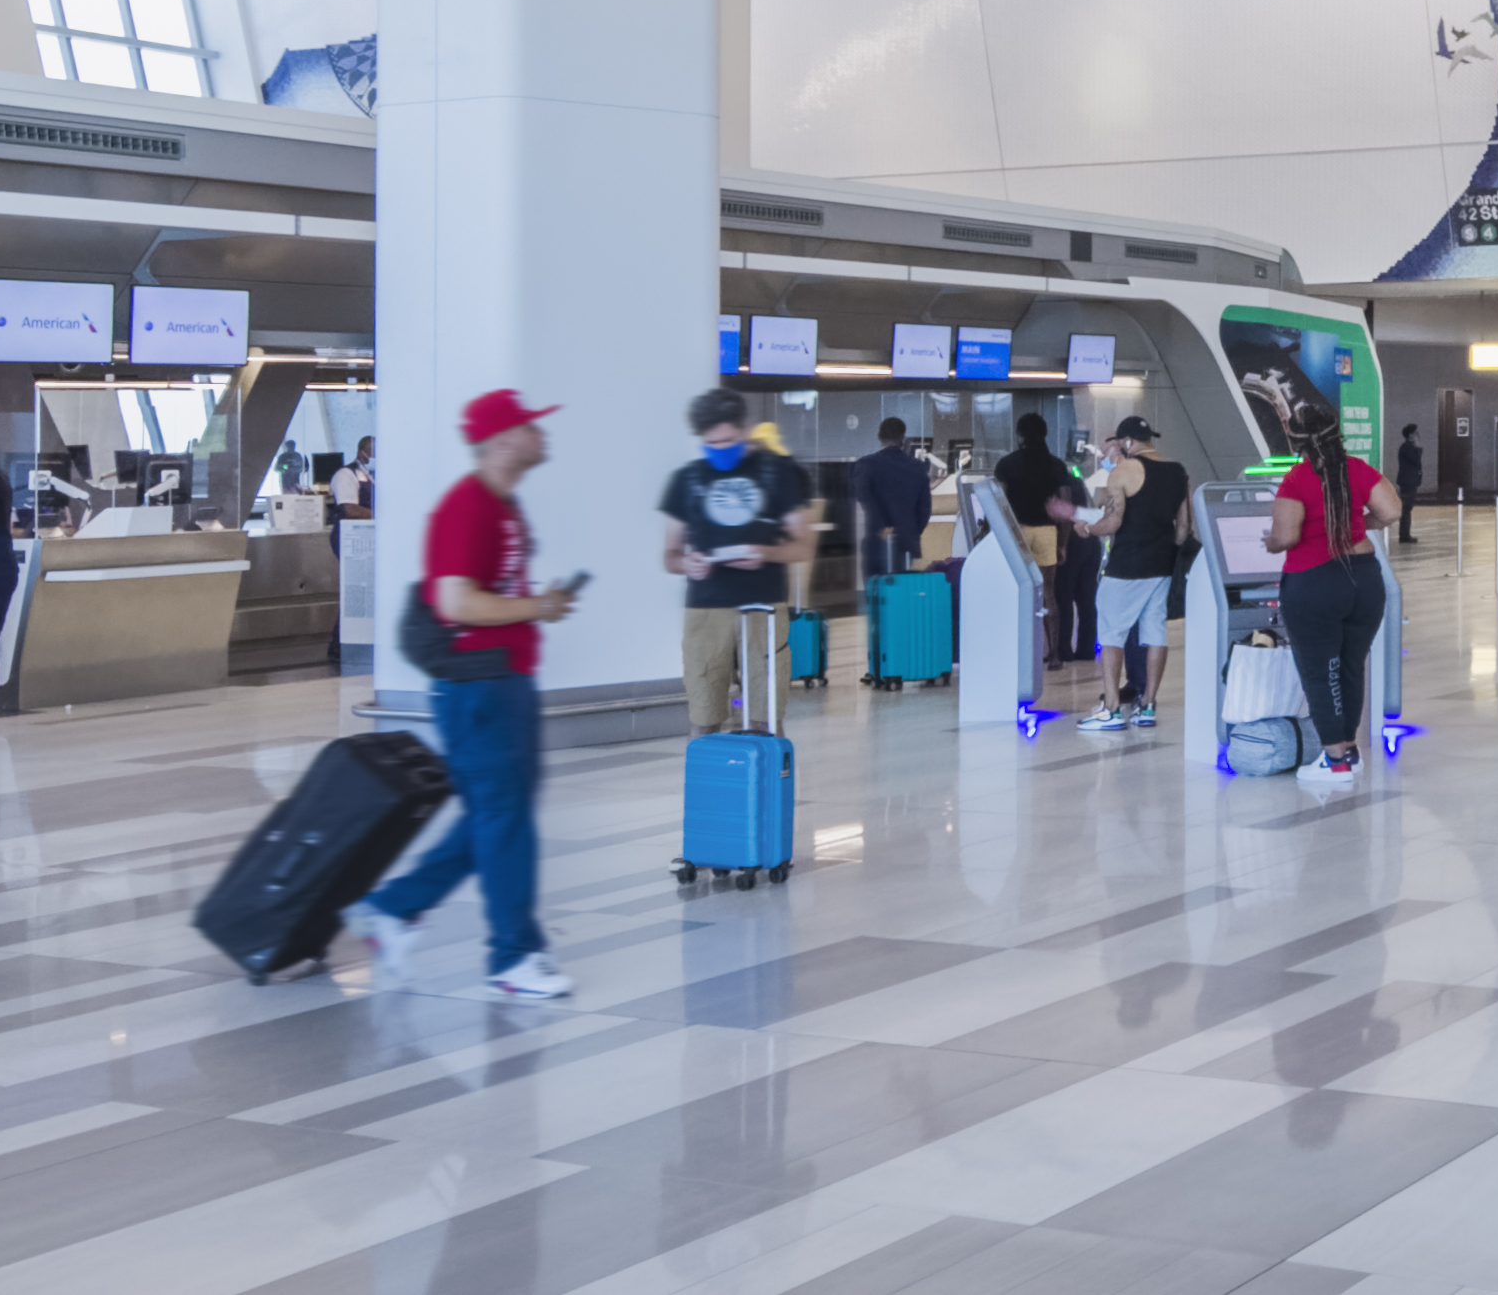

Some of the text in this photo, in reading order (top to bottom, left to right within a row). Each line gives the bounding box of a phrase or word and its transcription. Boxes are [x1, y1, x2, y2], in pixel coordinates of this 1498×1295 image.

[1465, 229, 1475, 240] S
[1483, 227, 1493, 238] 4
[21, 315, 80, 330] American
[166, 321, 219, 334] American
[769, 341, 800, 352] American
